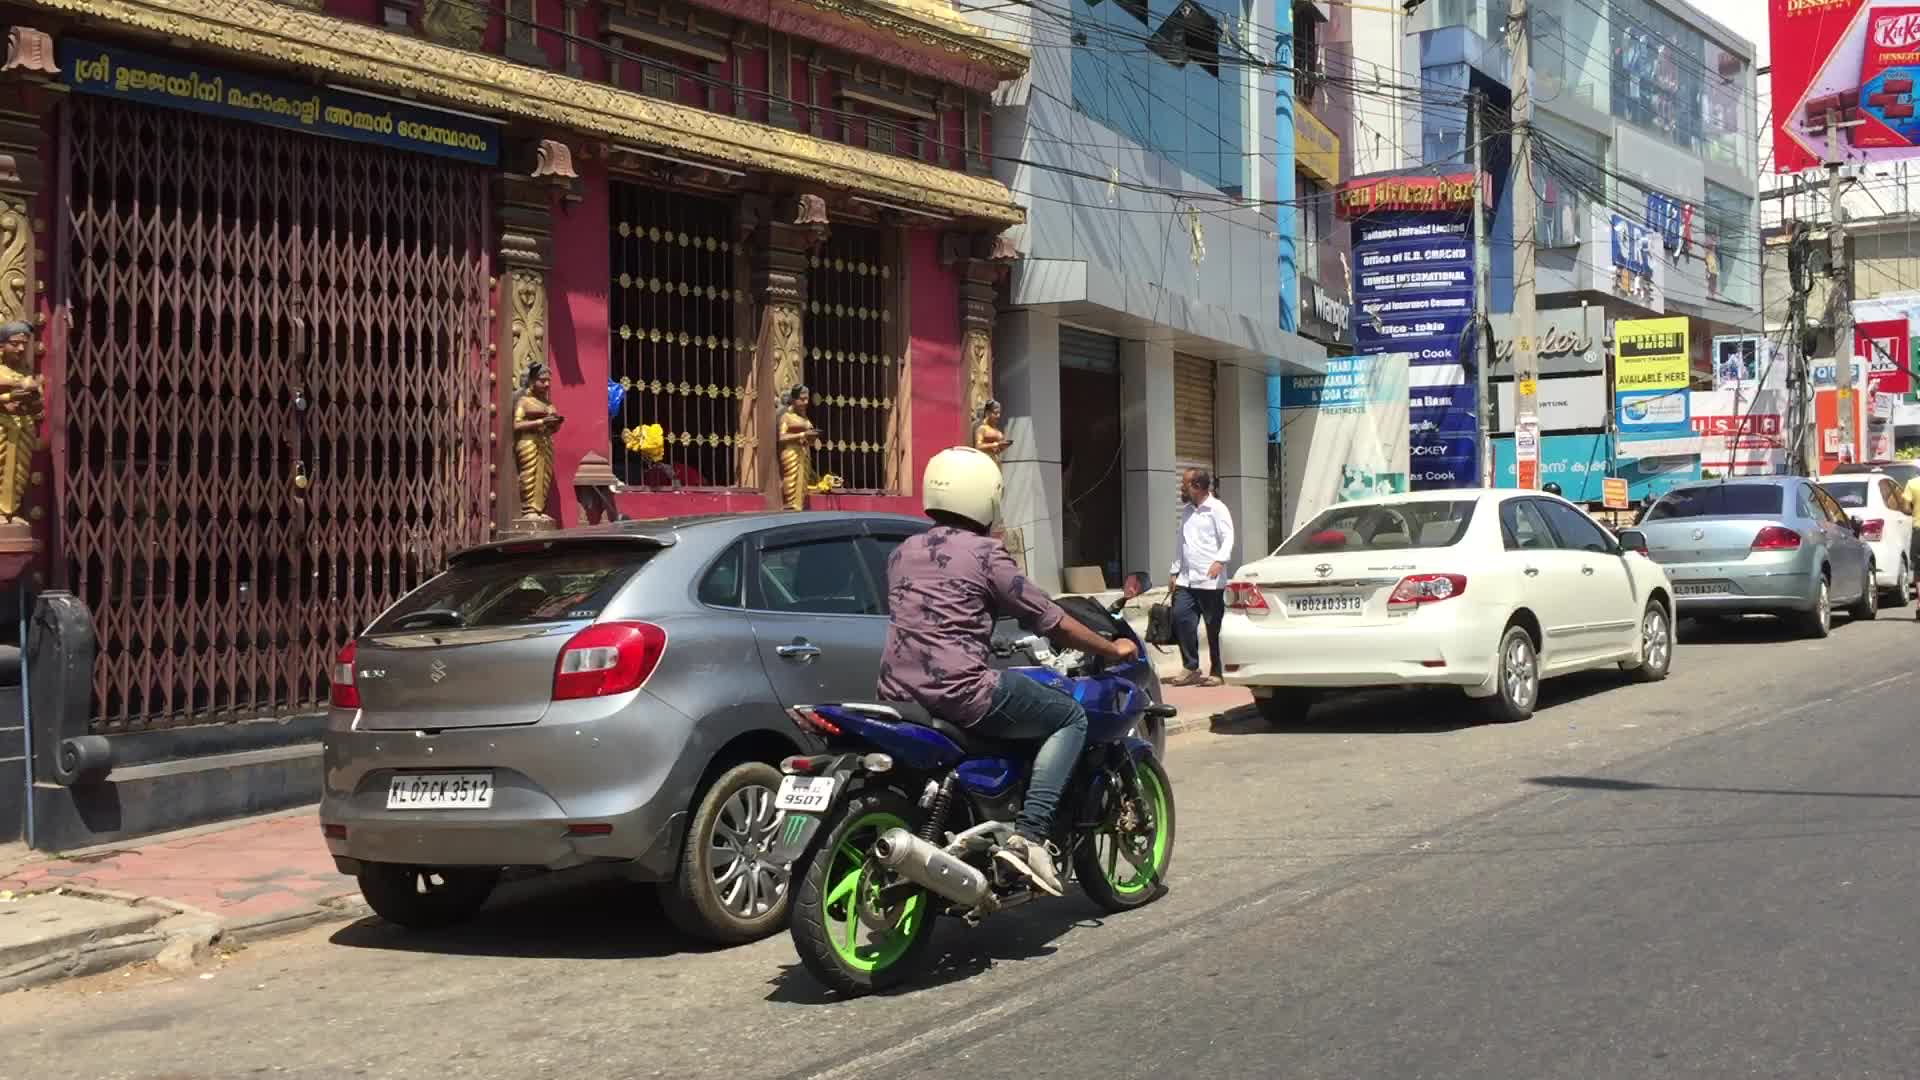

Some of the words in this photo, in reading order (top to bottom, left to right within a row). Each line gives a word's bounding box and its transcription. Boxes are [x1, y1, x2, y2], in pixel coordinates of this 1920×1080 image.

[227, 87, 321, 125] മഹാകാളി
[1363, 254, 1391, 267] Office
[1392, 253, 1402, 263] of
[1397, 271, 1466, 283] INTERNATIONAL
[1422, 348, 1452, 359] Cook
[1619, 372, 1662, 385] AVAILABLE
[1664, 371, 1687, 381] HERE
[1425, 470, 1456, 481] Cook
[784, 794, 824, 806] 9507
